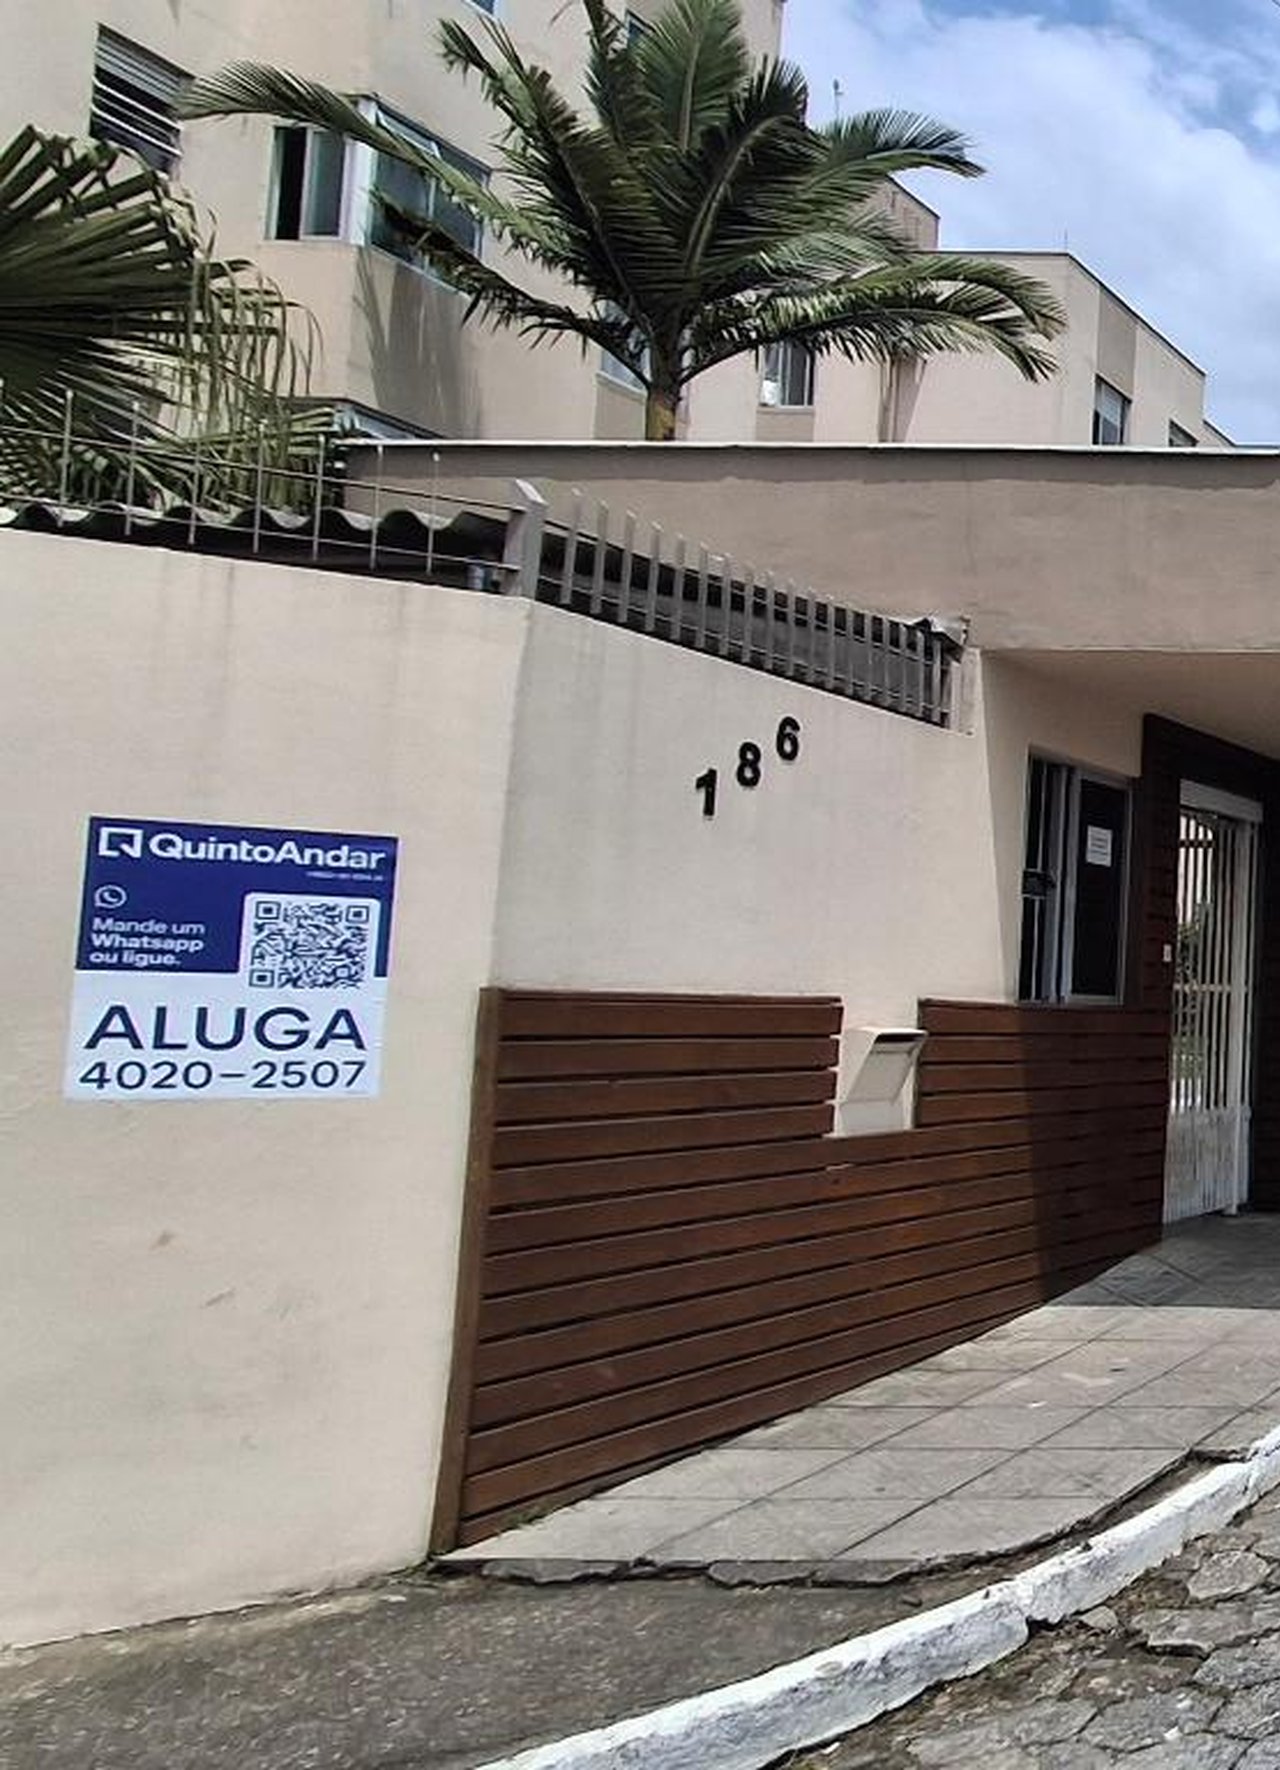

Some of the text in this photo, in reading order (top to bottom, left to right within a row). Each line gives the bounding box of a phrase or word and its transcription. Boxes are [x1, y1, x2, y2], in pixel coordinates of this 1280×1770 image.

[696, 716, 800, 816] 186
[149, 833, 386, 869] QuintoAndar
[92, 917, 205, 934] Mande um
[91, 933, 204, 953] Whatsapp
[89, 950, 181, 968] ou ligue.
[82, 1004, 367, 1051] ALUGA
[79, 1060, 367, 1090] 4020-2507
